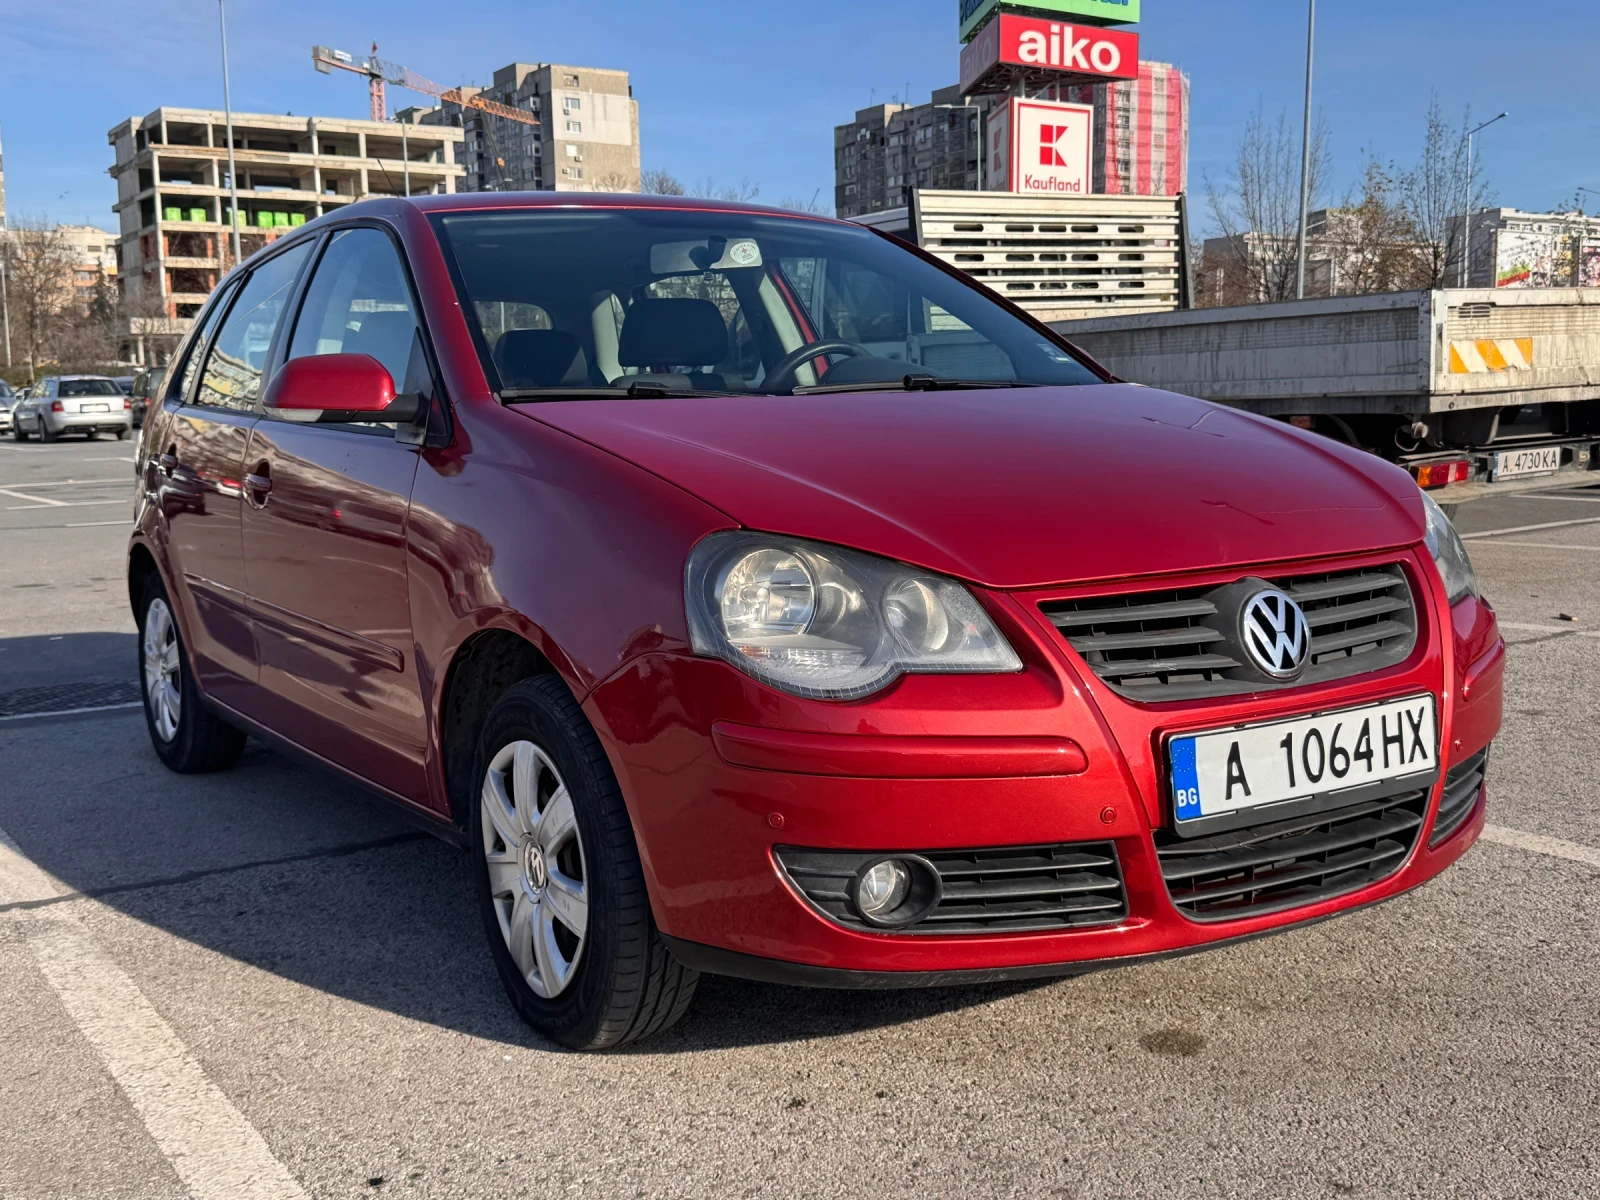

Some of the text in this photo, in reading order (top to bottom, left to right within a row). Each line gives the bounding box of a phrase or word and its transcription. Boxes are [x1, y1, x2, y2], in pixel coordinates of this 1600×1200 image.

[1018, 23, 1121, 73] aiko
[1024, 173, 1081, 193] Kaufland
[1225, 740, 1251, 800] A
[1177, 788, 1198, 807] BG
